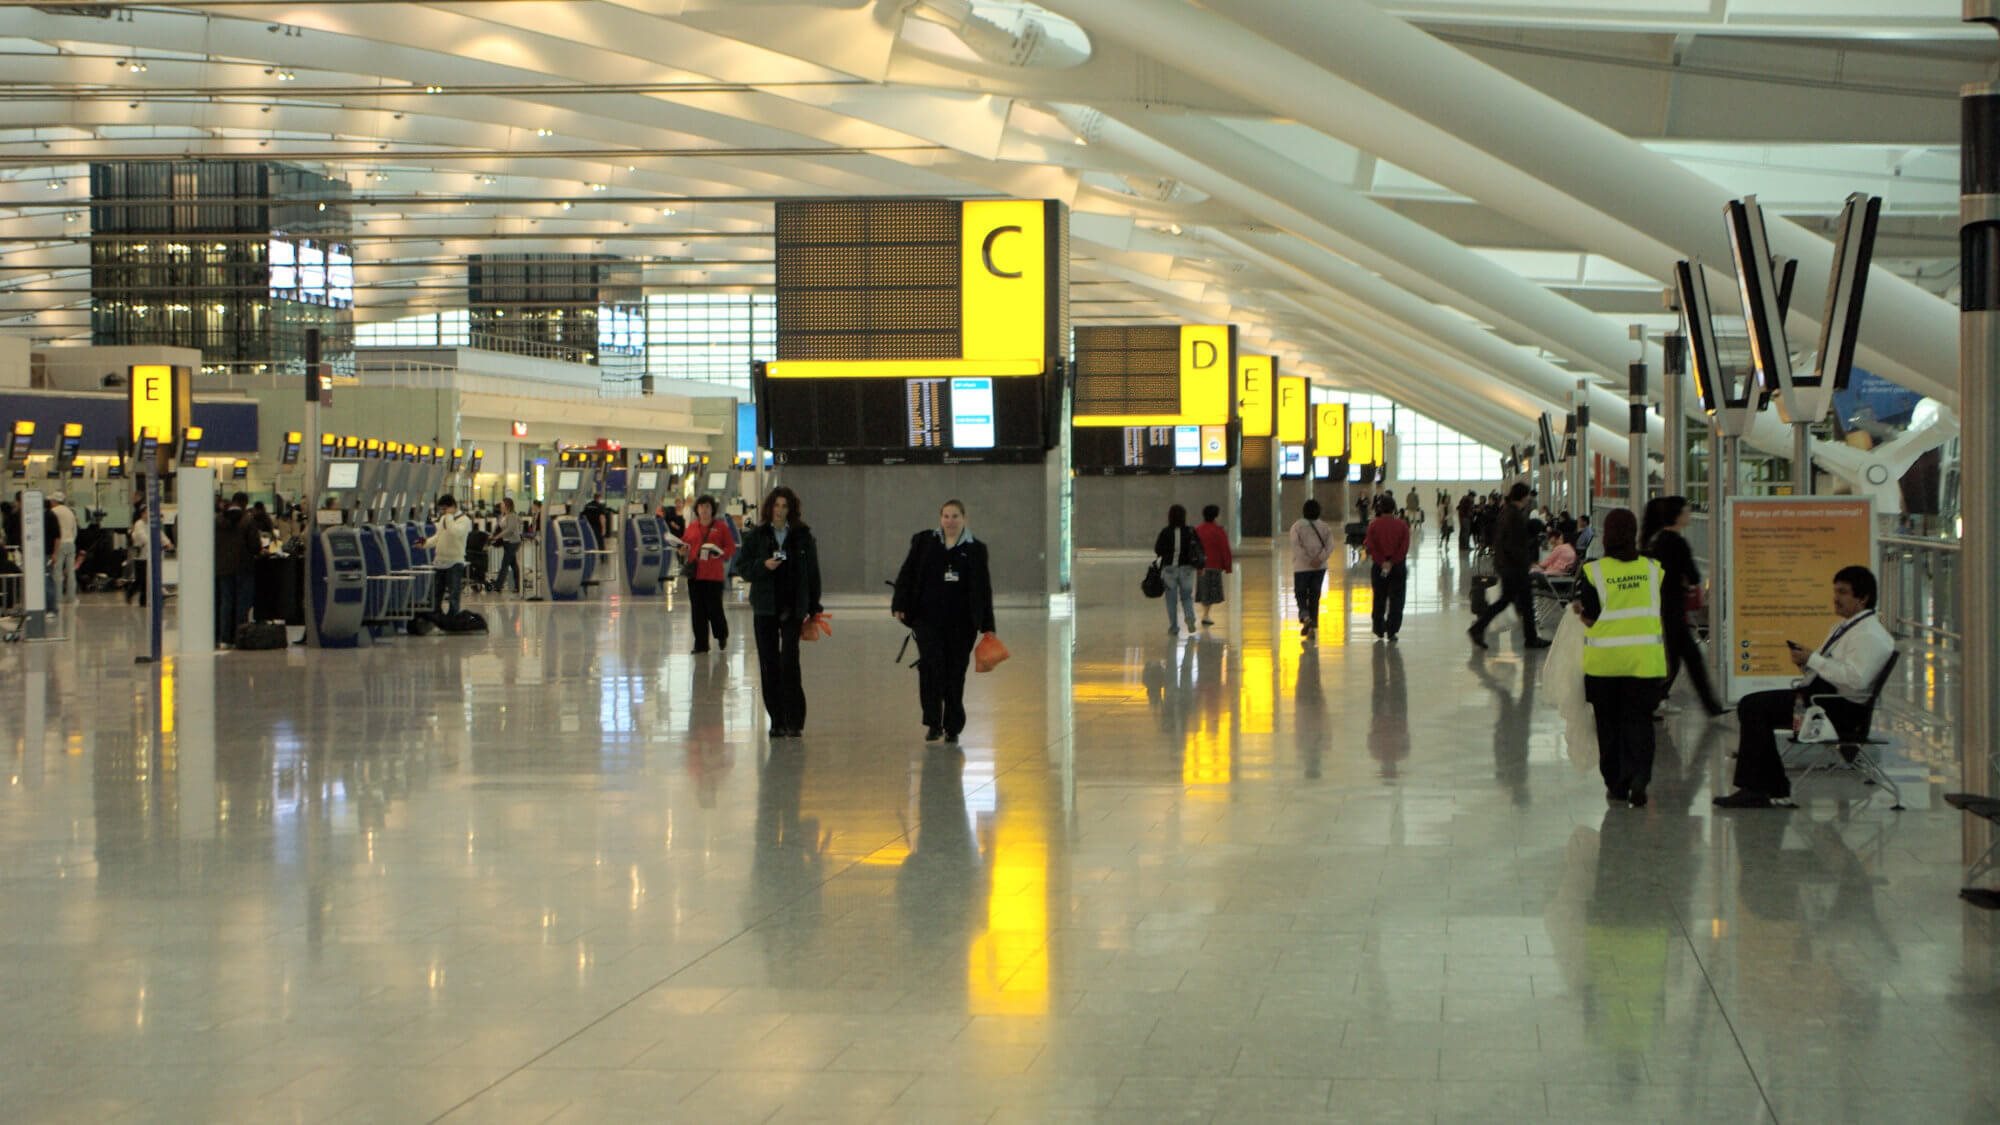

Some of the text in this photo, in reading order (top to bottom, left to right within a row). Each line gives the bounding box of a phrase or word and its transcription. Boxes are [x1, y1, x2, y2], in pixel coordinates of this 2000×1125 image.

[981, 225, 1023, 278] C
[1191, 340, 1218, 369] D
[145, 377, 160, 401] E
[1244, 368, 1259, 392] E
[1282, 387, 1294, 407] F
[1323, 410, 1338, 427] G
[1606, 575, 1648, 584] CLEANING
[1618, 582, 1639, 591] TEAM
